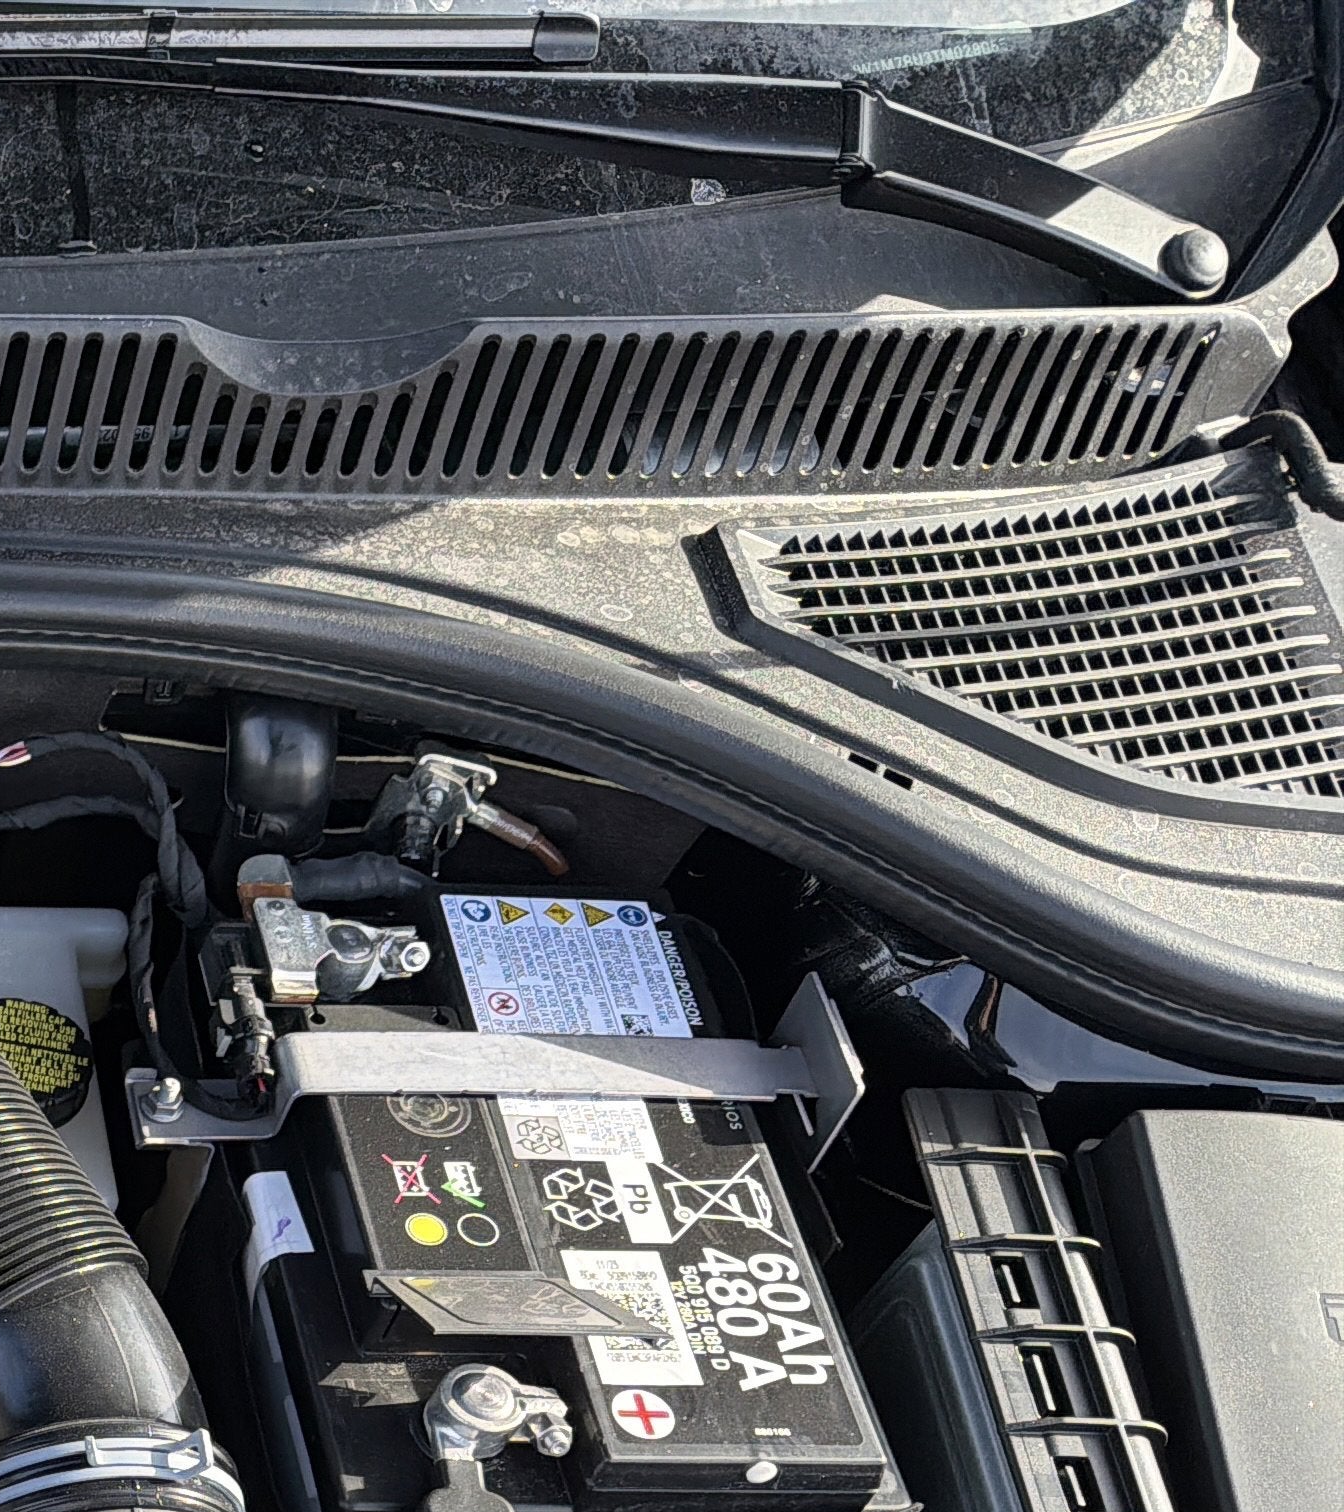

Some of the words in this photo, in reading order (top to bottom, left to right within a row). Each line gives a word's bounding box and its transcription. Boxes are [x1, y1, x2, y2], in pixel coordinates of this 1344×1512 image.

[656, 930, 703, 1024] DANGER/POISON
[621, 1184, 657, 1214] Pb
[686, 1332, 707, 1356] DIN
[689, 1298, 714, 1322] 915
[709, 1358, 731, 1370] D
[699, 1246, 766, 1337] 480
[736, 1348, 787, 1393] A
[746, 1250, 836, 1387] 60Ah
